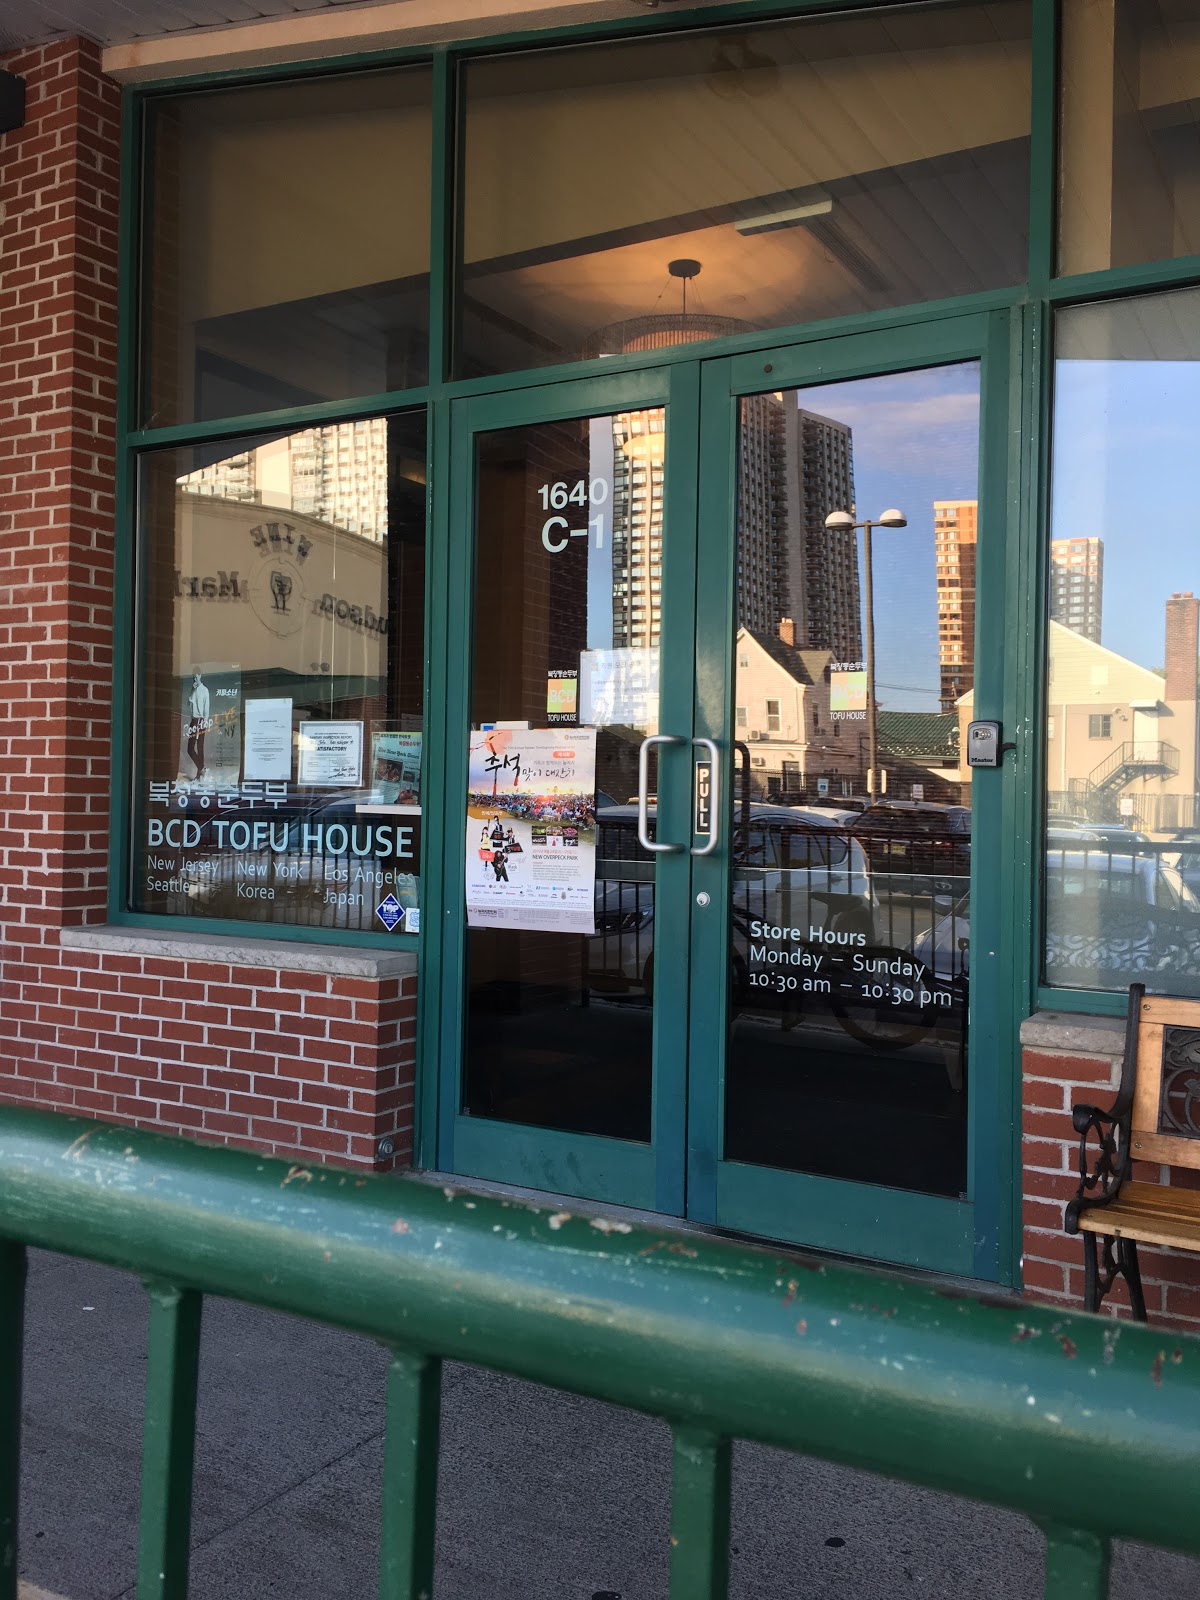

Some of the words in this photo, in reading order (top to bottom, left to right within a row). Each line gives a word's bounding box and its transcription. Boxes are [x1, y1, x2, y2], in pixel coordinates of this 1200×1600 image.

[537, 477, 609, 511] 1640
[541, 513, 605, 554] C-1
[550, 689, 575, 703] BCD
[548, 714, 560, 722] TOFU
[561, 714, 577, 722] HOUSE
[830, 712, 846, 720] TOFU
[846, 711, 867, 720] HOUSE
[149, 780, 287, 810] 북창동순두부
[699, 768, 710, 827] PULL
[148, 818, 201, 848] BCD
[212, 820, 289, 852] TOFU
[303, 823, 414, 858] HOUSE
[147, 855, 175, 871] New
[180, 856, 219, 878] Jersey
[237, 860, 268, 877] New
[273, 861, 303, 879] York
[324, 864, 349, 882] Los
[354, 866, 414, 889] Angeles
[147, 875, 190, 894] Seattle
[236, 882, 275, 900] Korea
[323, 888, 364, 910] Japan
[750, 921, 801, 941] Store
[809, 925, 866, 947] Hours
[750, 944, 823, 972] Monday
[852, 954, 926, 982] Sunday
[749, 971, 798, 993] 10:30
[802, 978, 832, 993] am
[861, 982, 914, 1006] 10:30
[920, 990, 952, 1009] pm
